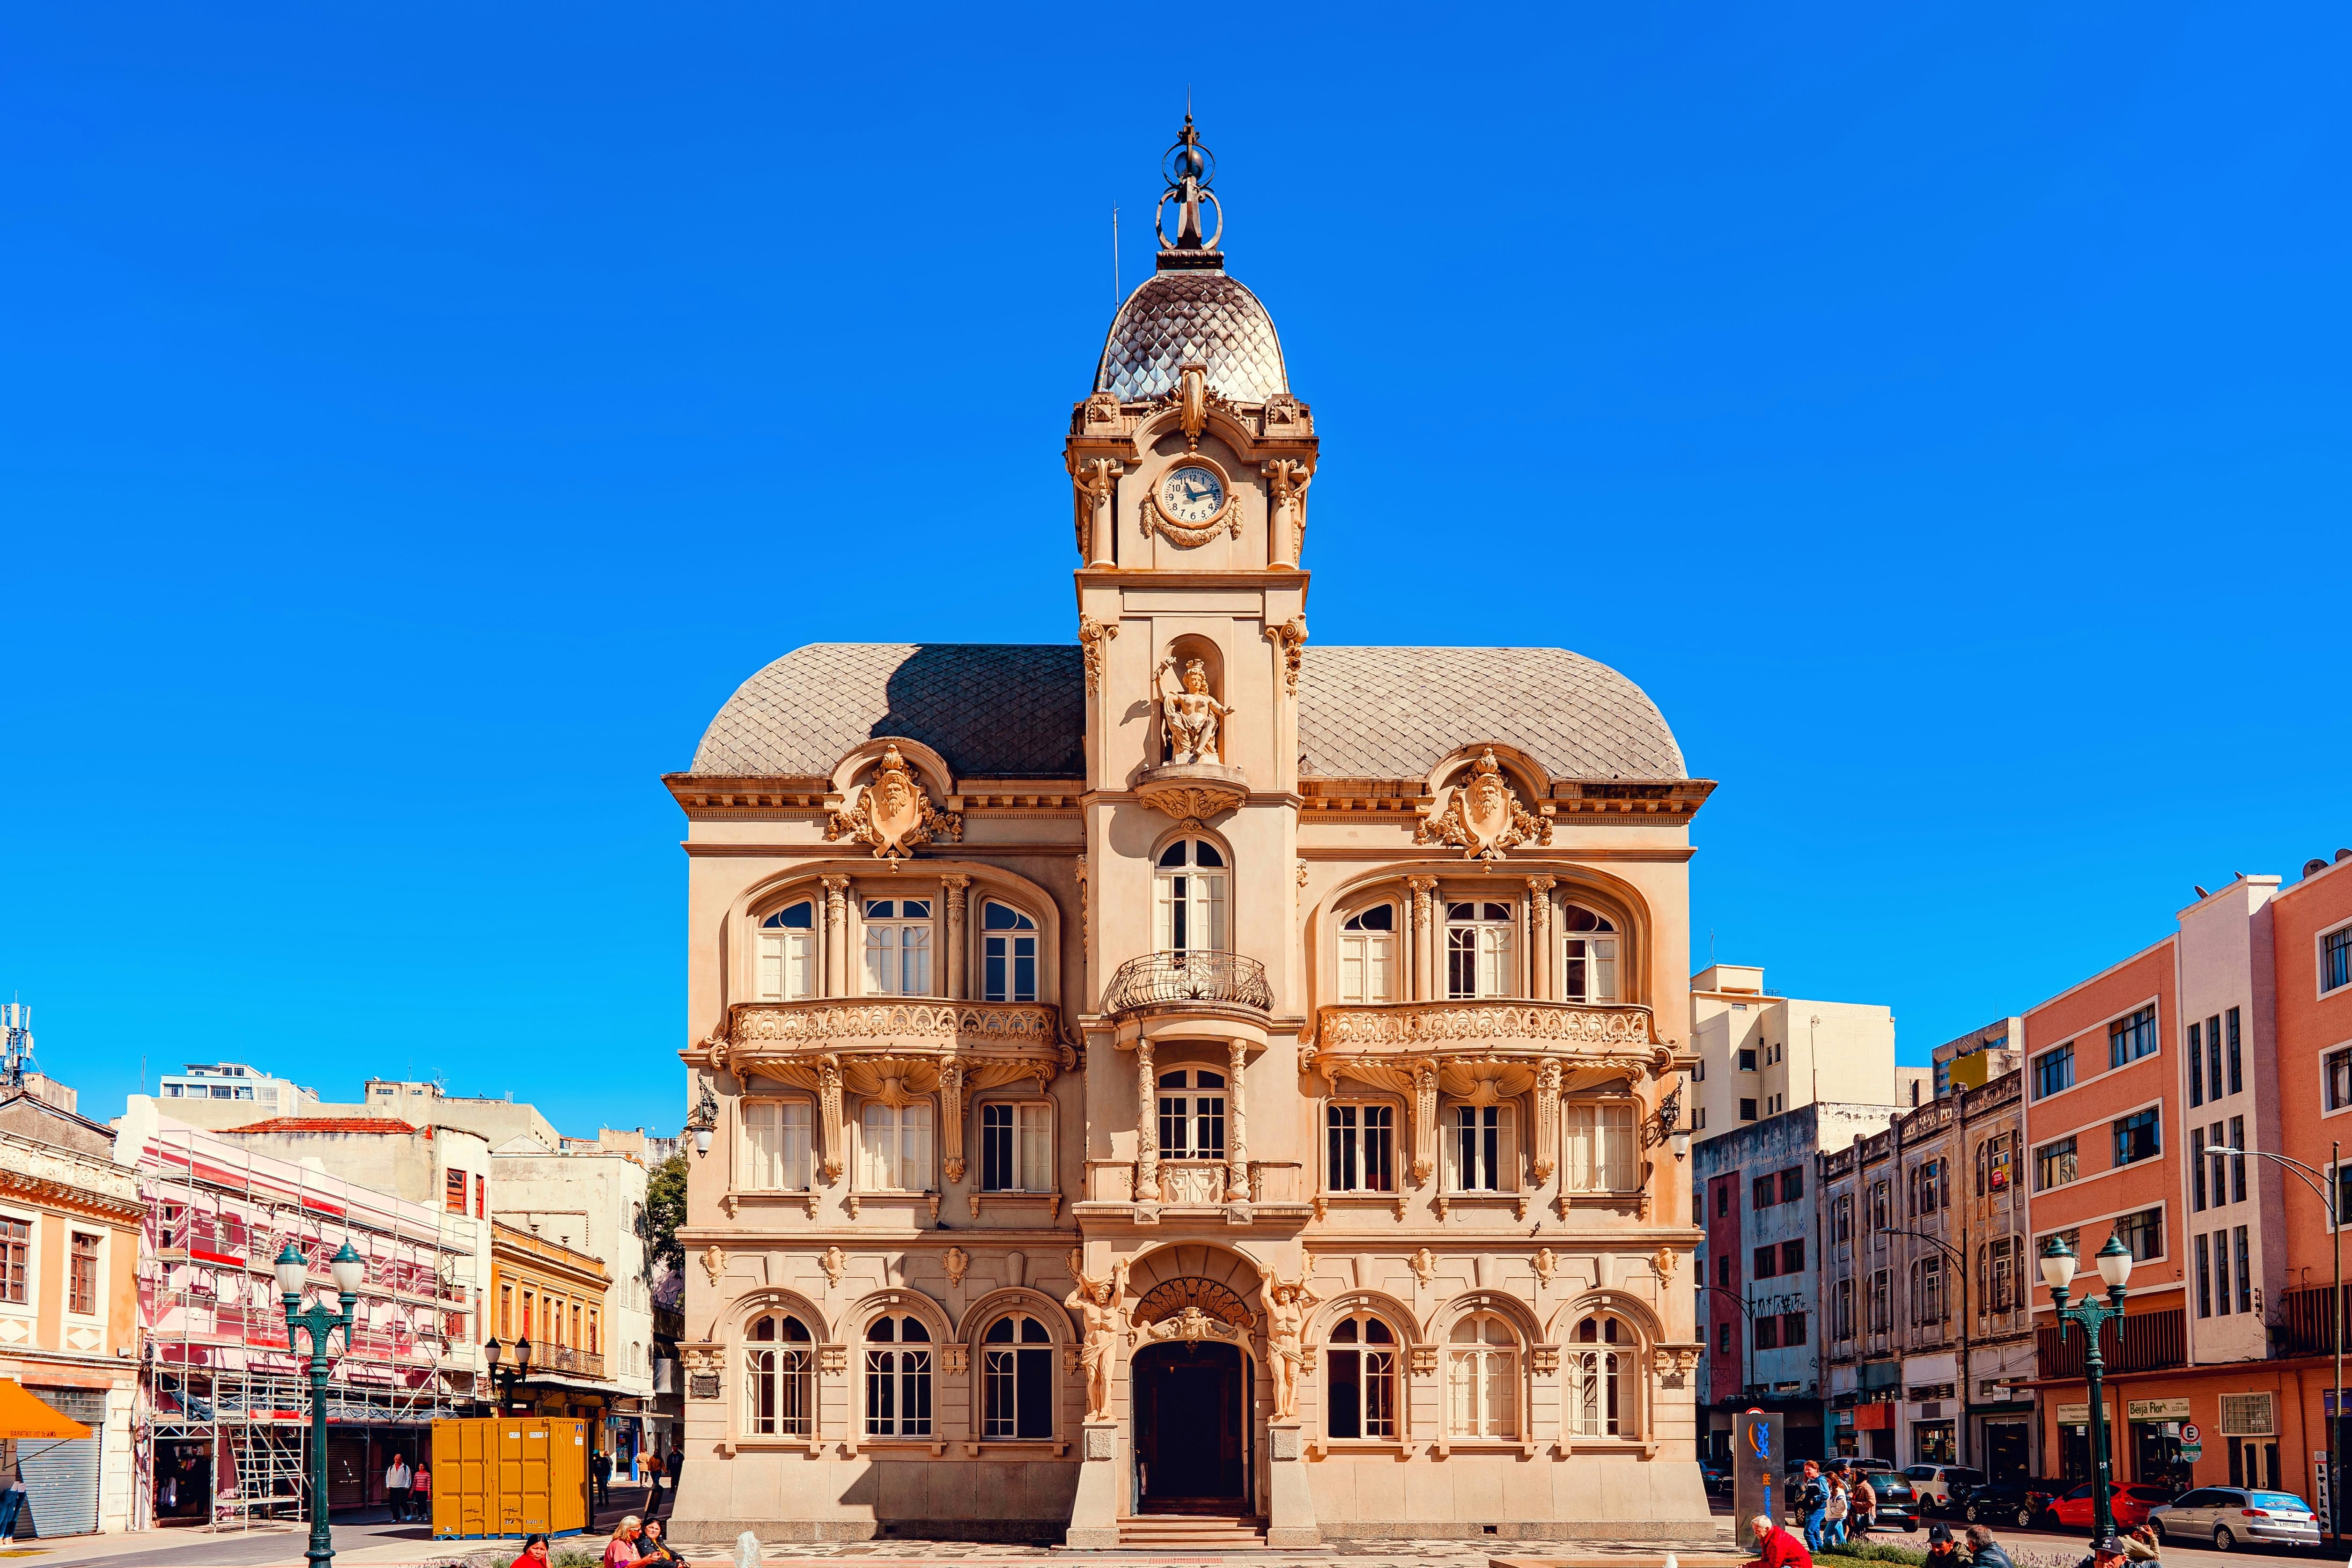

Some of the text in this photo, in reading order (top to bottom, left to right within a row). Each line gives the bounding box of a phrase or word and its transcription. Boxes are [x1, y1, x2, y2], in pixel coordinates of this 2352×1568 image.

[2130, 1402, 2163, 1416] Beija Flor
[2187, 1428, 2194, 1438] E
[1762, 1473, 1770, 1485] PR
